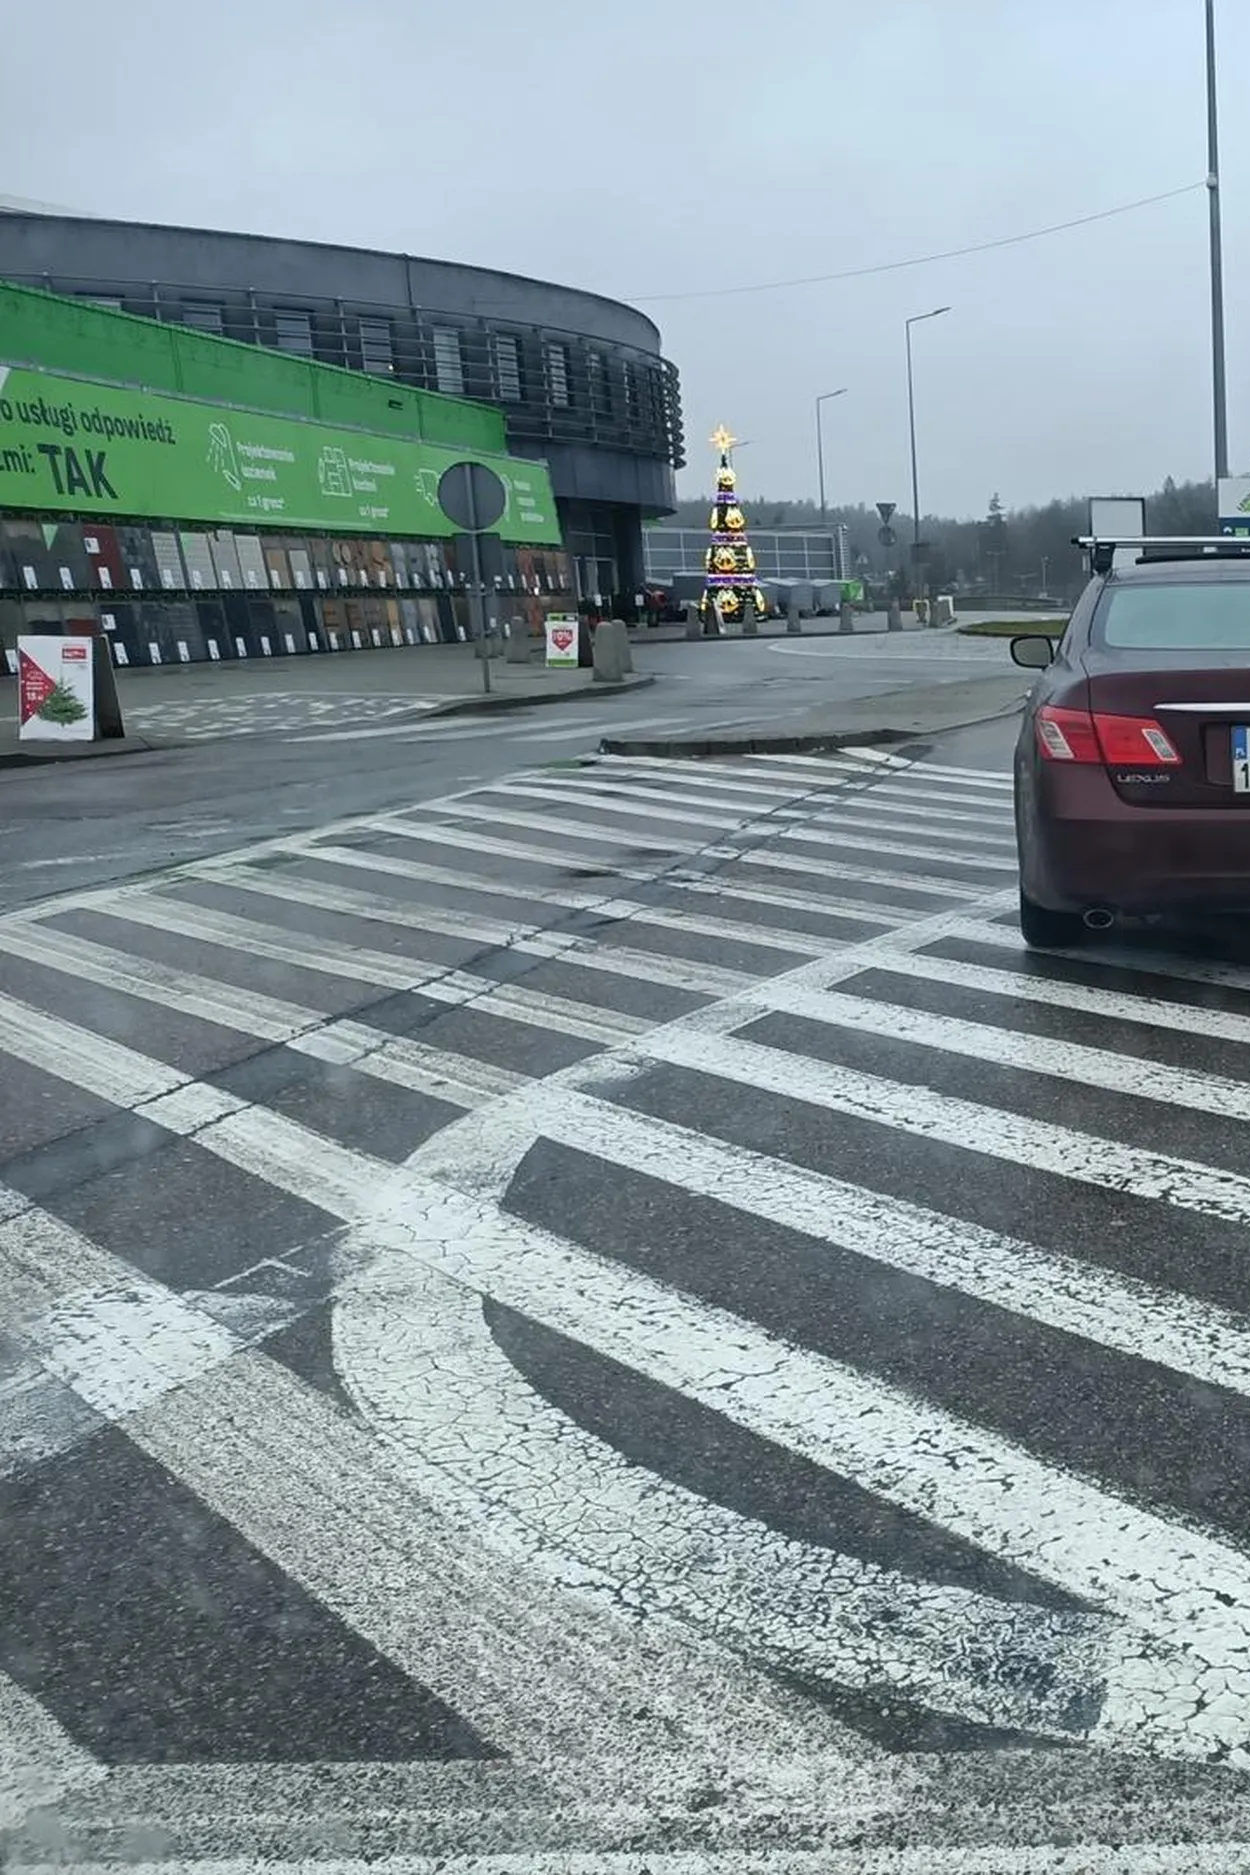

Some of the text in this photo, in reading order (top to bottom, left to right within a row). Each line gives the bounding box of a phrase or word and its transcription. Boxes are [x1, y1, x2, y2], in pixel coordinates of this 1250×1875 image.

[16, 397, 78, 437] usługi
[0, 443, 118, 499] mi: TAK
[1117, 773, 1170, 783] LEXUS
